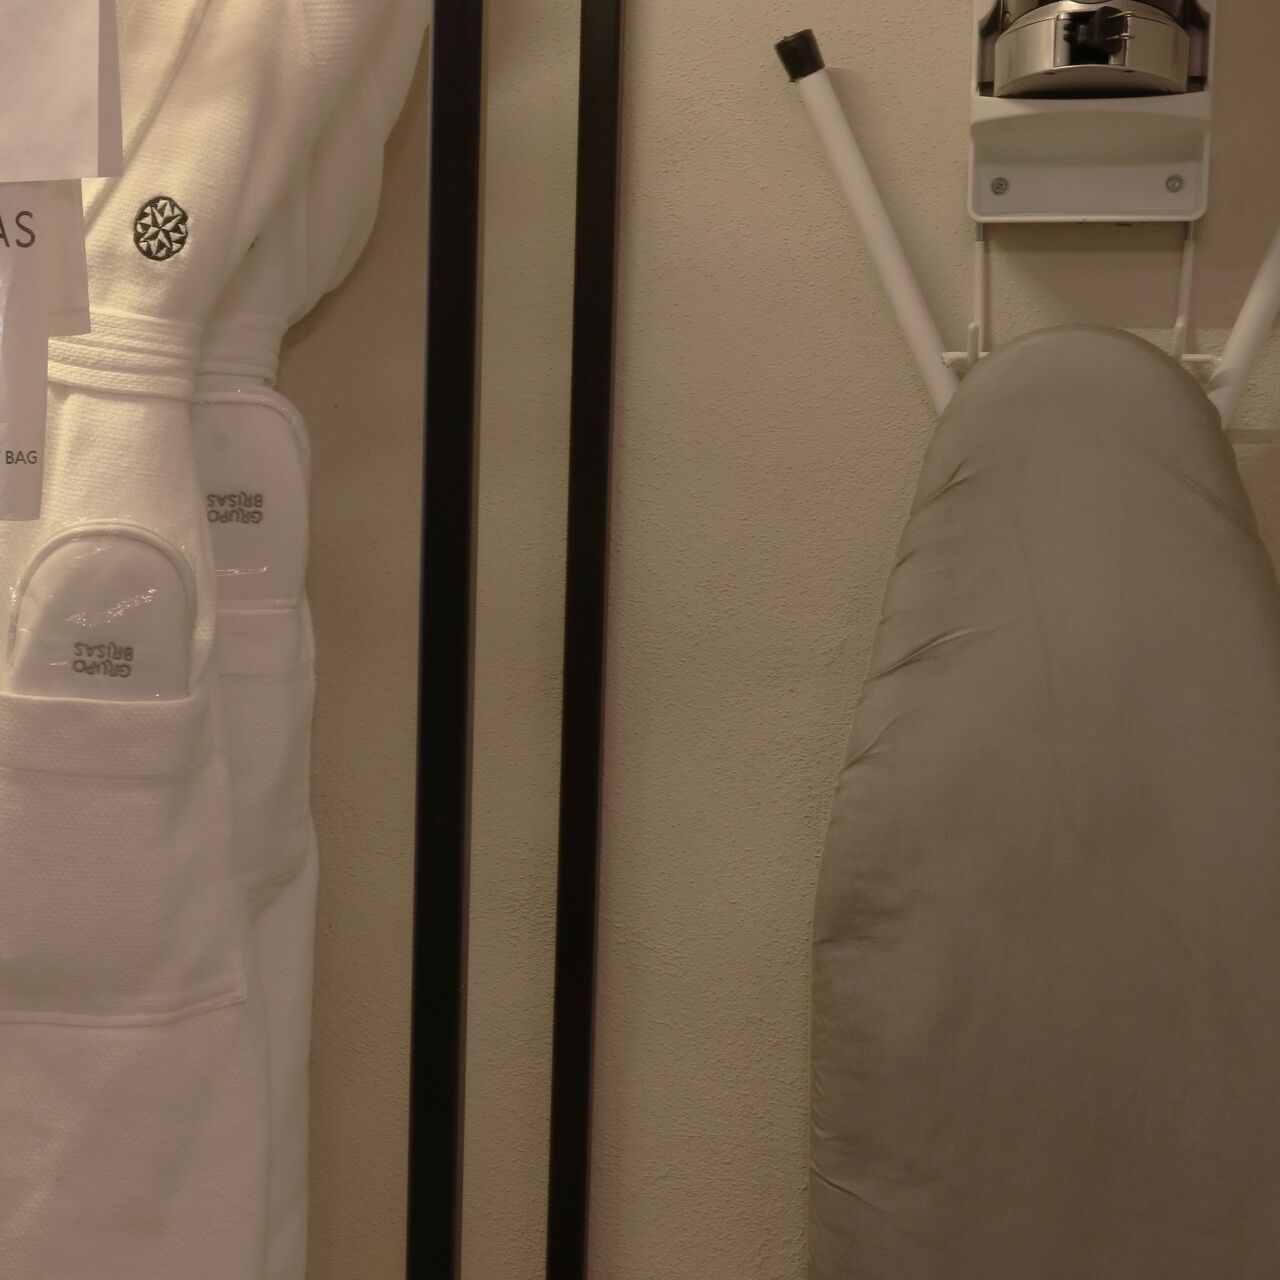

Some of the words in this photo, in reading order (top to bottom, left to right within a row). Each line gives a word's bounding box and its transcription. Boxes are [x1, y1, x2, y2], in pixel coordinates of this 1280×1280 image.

[5, 450, 38, 465] BAG
[207, 491, 264, 508] BRISAS
[207, 507, 263, 525] GRUPO
[74, 641, 134, 662] BRISAS
